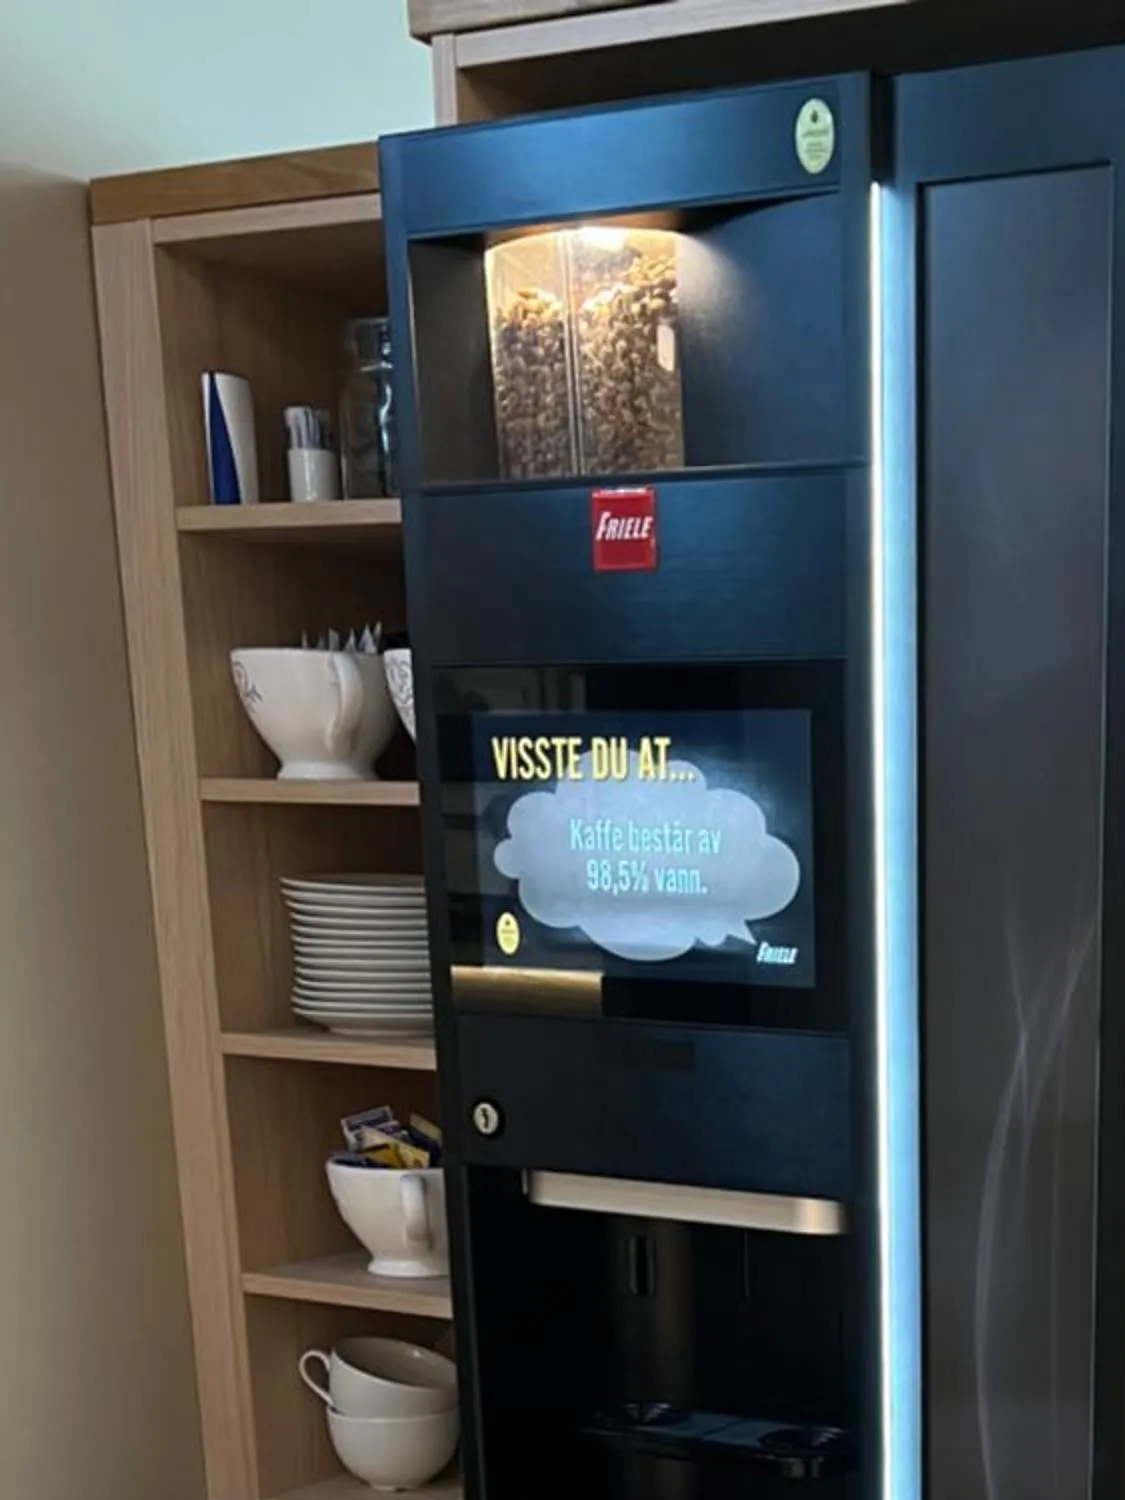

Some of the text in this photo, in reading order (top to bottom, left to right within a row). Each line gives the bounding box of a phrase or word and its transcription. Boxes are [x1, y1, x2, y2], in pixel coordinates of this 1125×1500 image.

[596, 511, 653, 541] FRIELE
[491, 736, 697, 782] VISSTE DU AT...
[570, 818, 722, 855] Kaffe består av
[586, 857, 709, 897] 98,5% vann.
